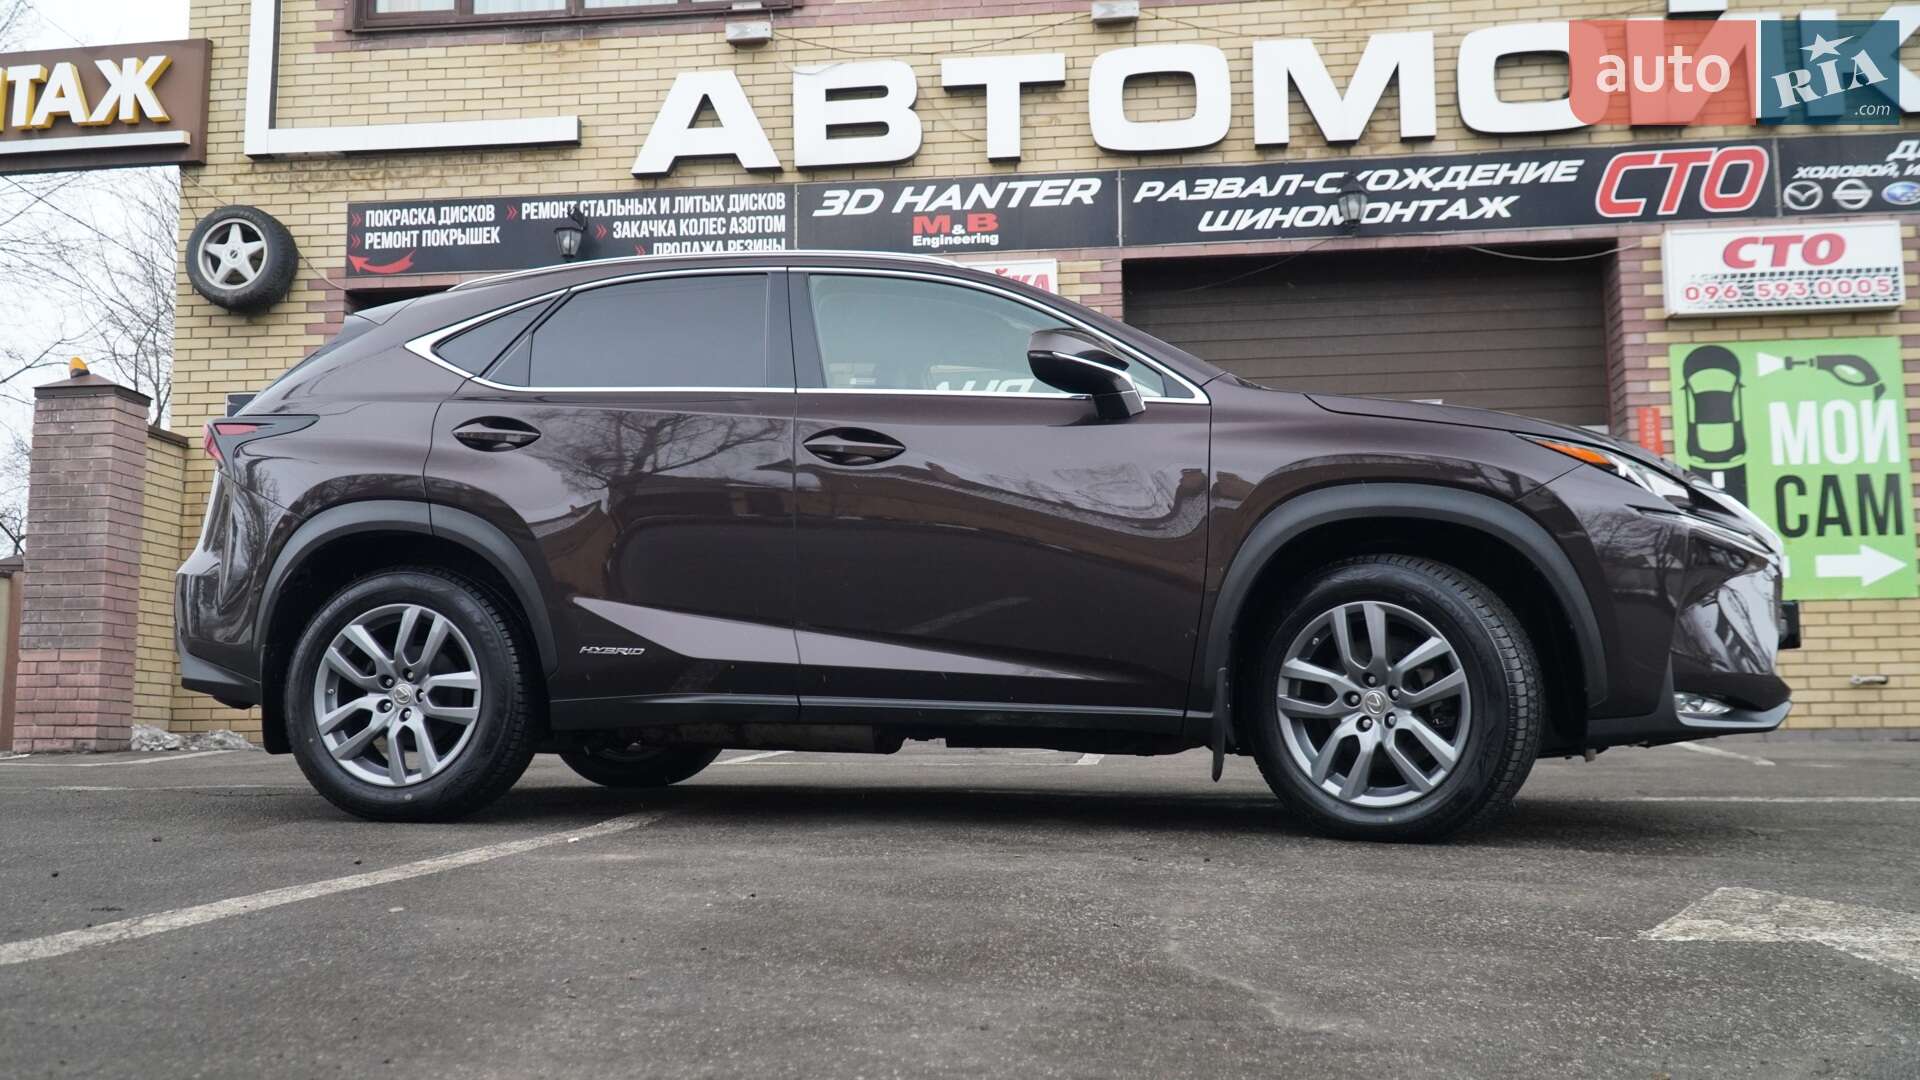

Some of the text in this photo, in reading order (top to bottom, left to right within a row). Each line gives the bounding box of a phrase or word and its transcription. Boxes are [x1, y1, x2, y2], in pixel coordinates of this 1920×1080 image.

[0, 54, 173, 133] ТАЖ
[1132, 158, 1585, 203] РАЗВАЛ-СОЖДЕНИЕ
[1595, 145, 1770, 218] СТО
[579, 197, 657, 218] СТАЛЬНЫХ
[660, 197, 670, 214] И
[673, 194, 724, 213] ЛИТЫХ
[727, 192, 786, 213] ДИСКОВ
[812, 177, 1102, 217] 3D HANTER
[365, 204, 496, 228] ПОКРАСКА ДИСКОВ
[612, 214, 786, 239] ЗАКАЧКА КОЛЕС АЗОТОМ
[1197, 196, 1520, 232] ШИНОМОНТАЖ
[365, 226, 501, 249] РЕМОНТ ПОКРЫШЕК
[912, 232, 999, 248] Engineering
[1722, 232, 1846, 270] СТО
[1684, 278, 1891, 302] 096 593 0005
[1774, 473, 1905, 538] САМ
[579, 646, 646, 656] HYBRID
